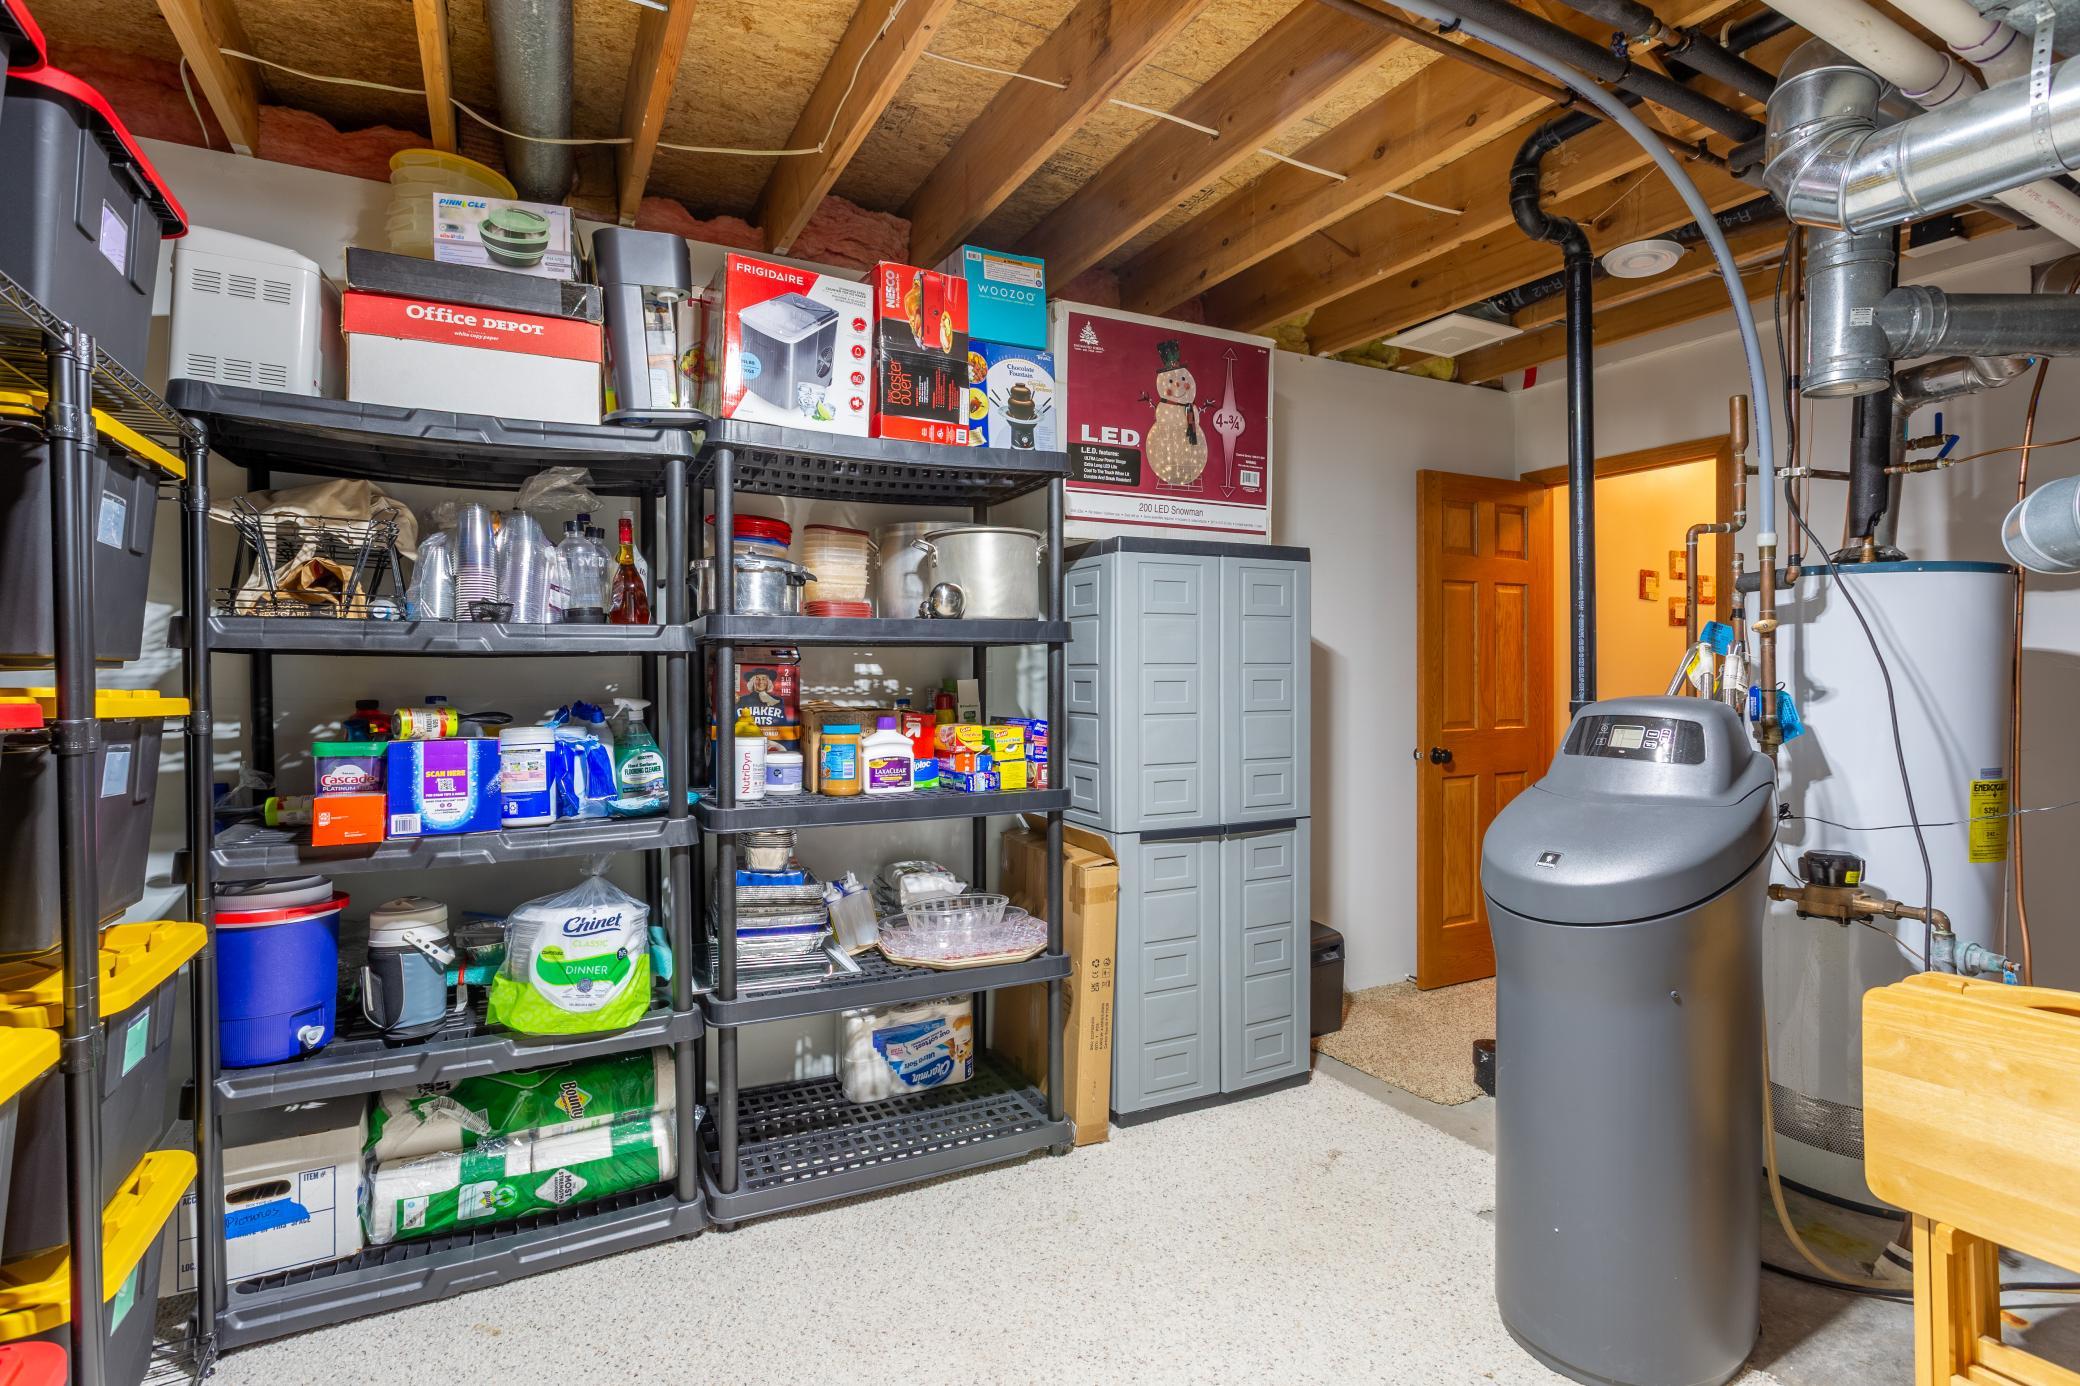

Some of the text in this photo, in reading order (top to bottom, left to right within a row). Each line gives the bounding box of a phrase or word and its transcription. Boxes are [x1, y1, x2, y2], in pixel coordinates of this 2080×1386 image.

[736, 262, 804, 286] FRIGIDAIRE
[886, 270, 896, 308] NESCO
[978, 284, 1034, 302] WOOZOO
[406, 304, 544, 335] Office DEPOT
[1007, 364, 1034, 373] Chocolate
[1009, 370, 1033, 378] Fountain
[888, 360, 902, 404] roaster
[900, 374, 912, 406] oven
[1082, 424, 1140, 448] L.E.D.
[1081, 446, 1098, 454] L.E.D.
[1139, 503, 1204, 516] 200 LED Snowman
[784, 668, 789, 676] 2
[754, 716, 772, 726] ATS
[742, 752, 752, 794] NutriDyn
[914, 760, 930, 771] iploc
[322, 774, 375, 786] Cascade
[562, 912, 622, 934] Chinet
[566, 966, 608, 974] DINNER
[904, 1052, 935, 1069] Ultra Soft
[912, 1060, 950, 1083] Charmin
[561, 1082, 583, 1118] Bounty
[304, 1173, 318, 1182] ITEM
